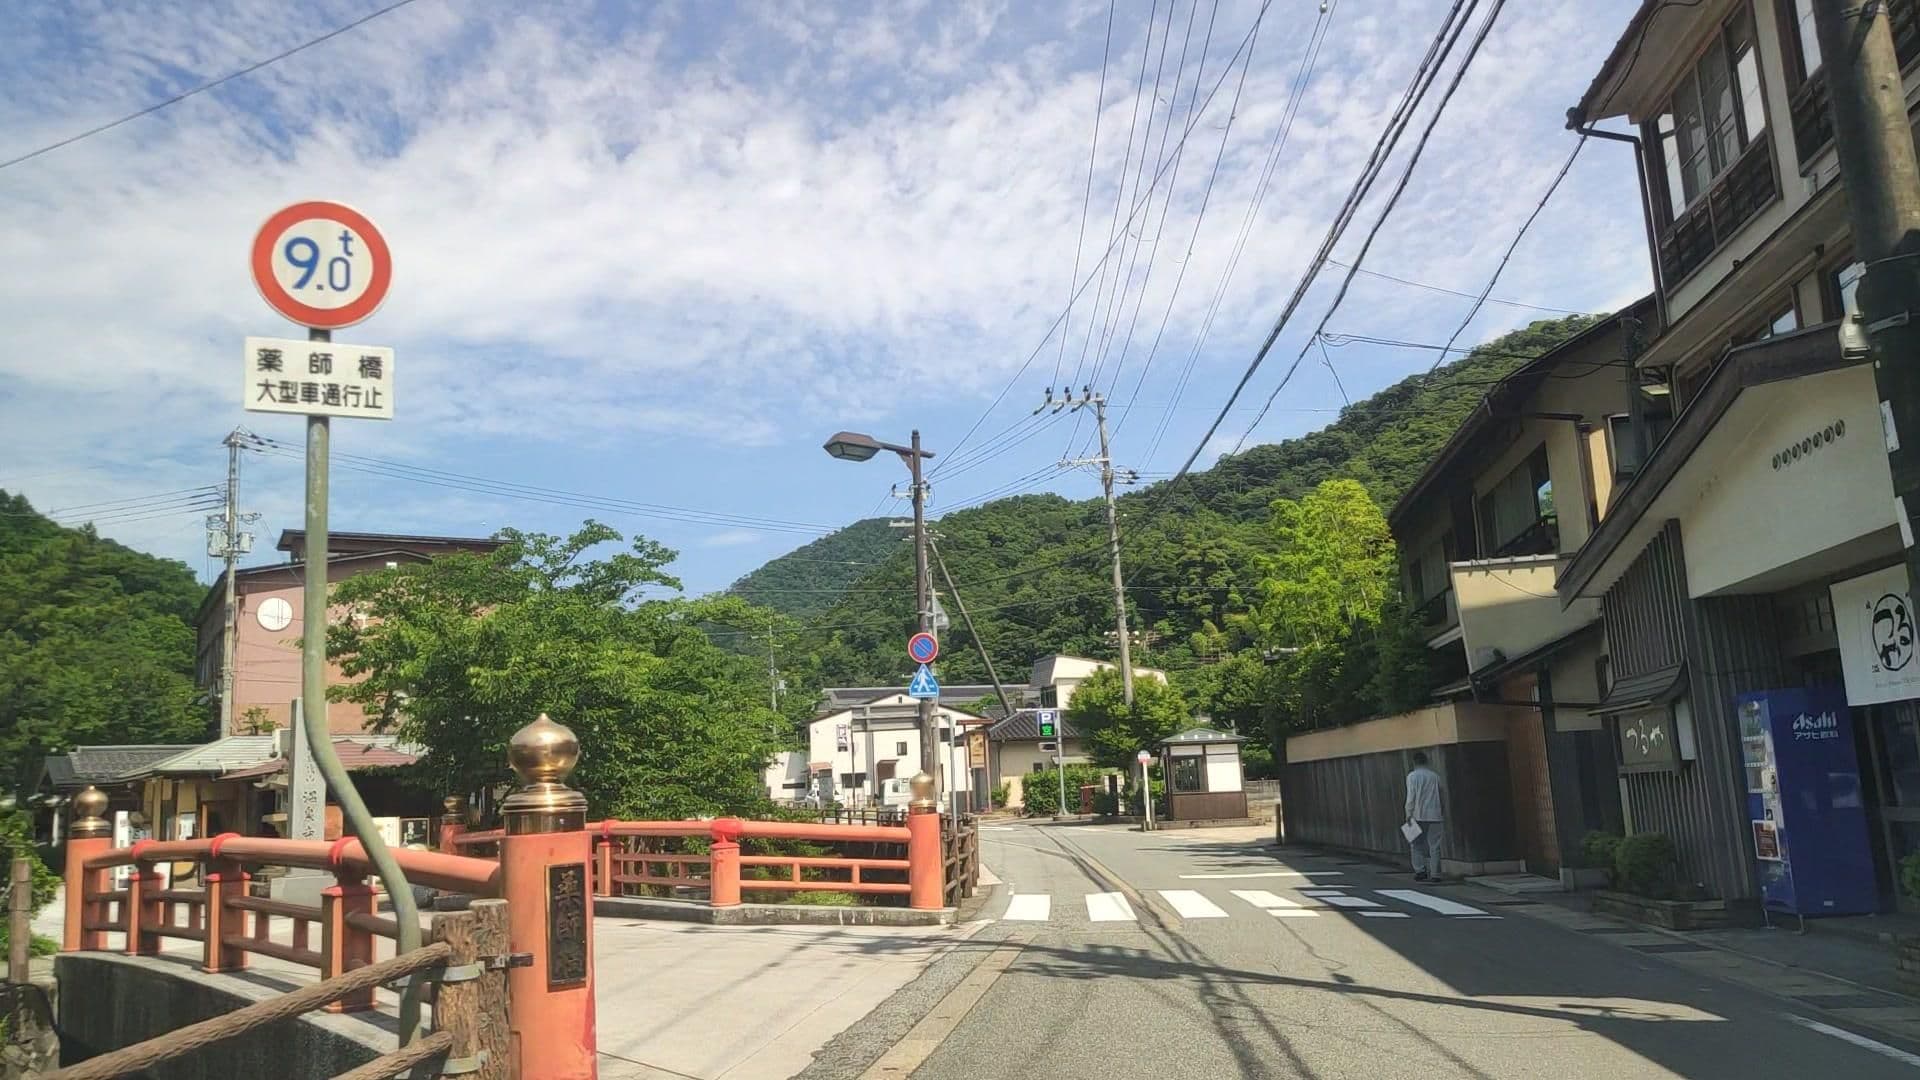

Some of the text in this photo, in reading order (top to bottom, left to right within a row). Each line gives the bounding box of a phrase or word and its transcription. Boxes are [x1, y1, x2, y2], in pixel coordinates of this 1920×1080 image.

[257, 348, 384, 379] 薬師橋
[256, 379, 383, 410] 大型車通行止
[1041, 713, 1052, 724] P
[1792, 711, 1837, 730] Asahi
